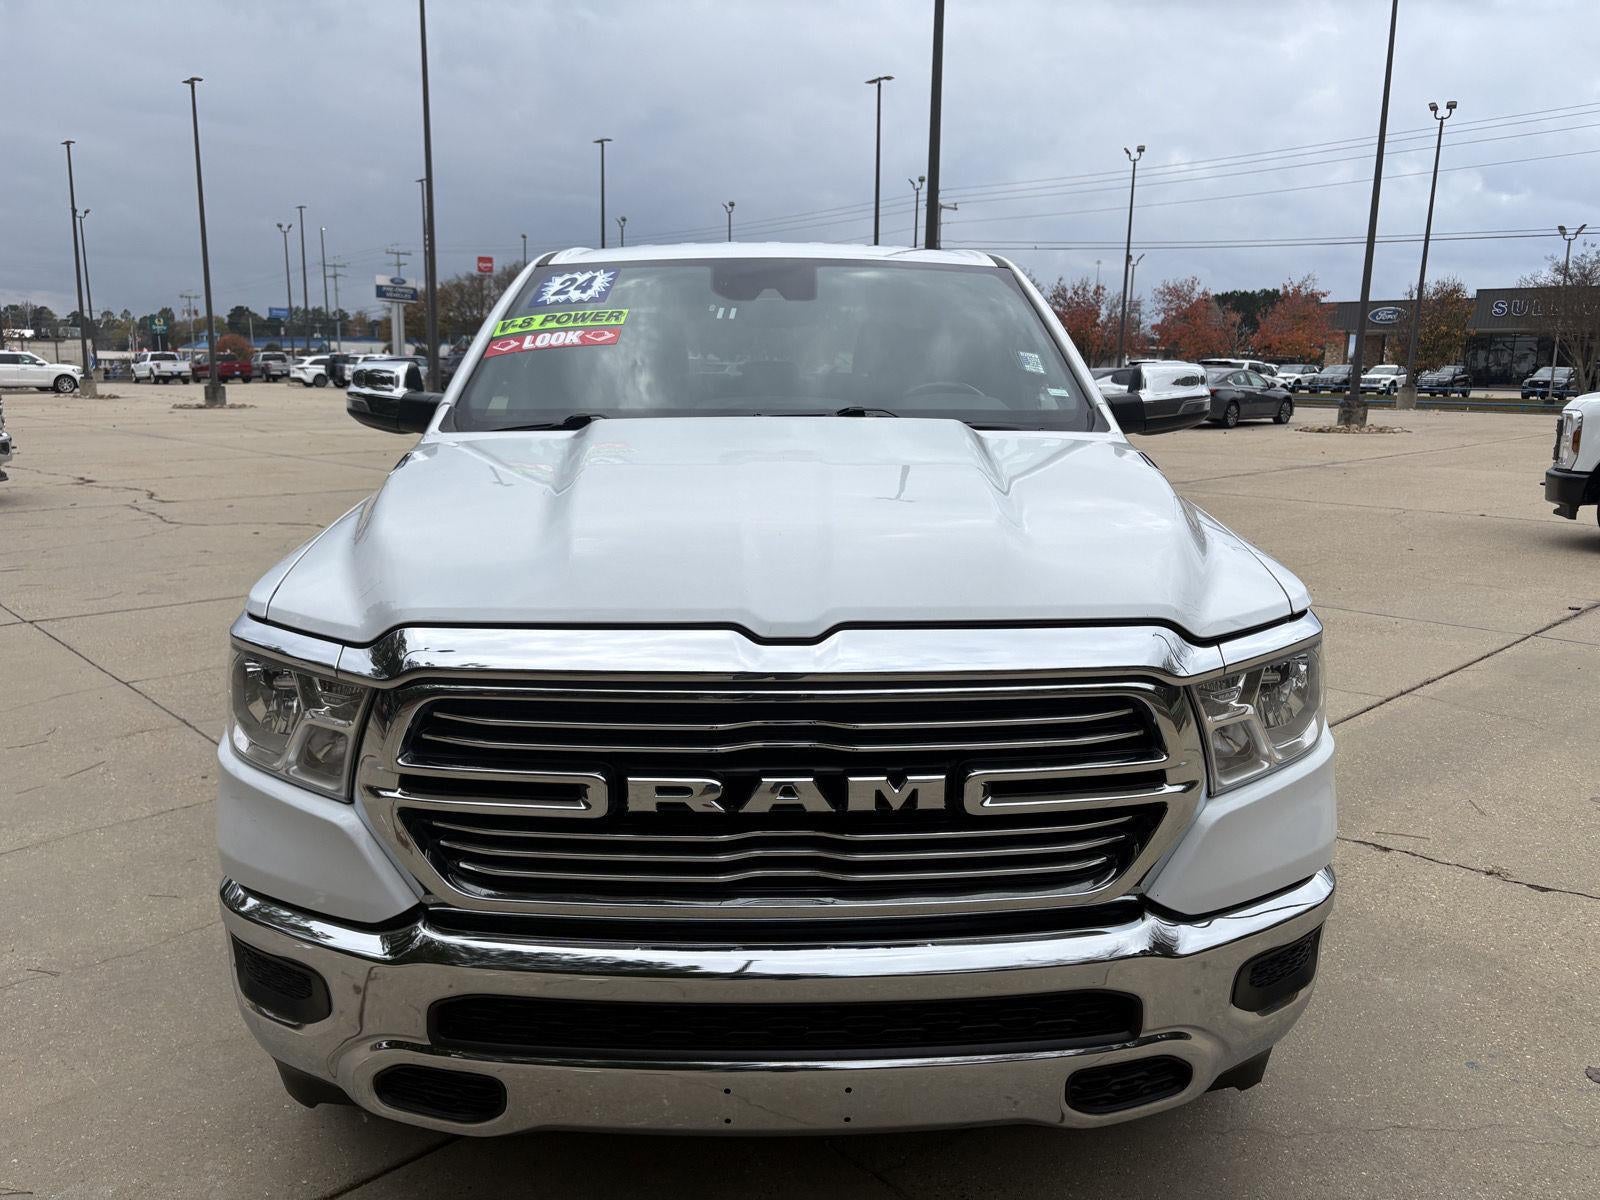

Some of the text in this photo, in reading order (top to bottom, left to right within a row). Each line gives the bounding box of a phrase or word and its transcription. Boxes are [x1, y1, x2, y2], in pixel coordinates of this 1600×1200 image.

[550, 275, 598, 296] 24
[500, 310, 624, 333] V-8 POWER
[522, 331, 584, 349] LOOK
[627, 775, 946, 812] RAM
